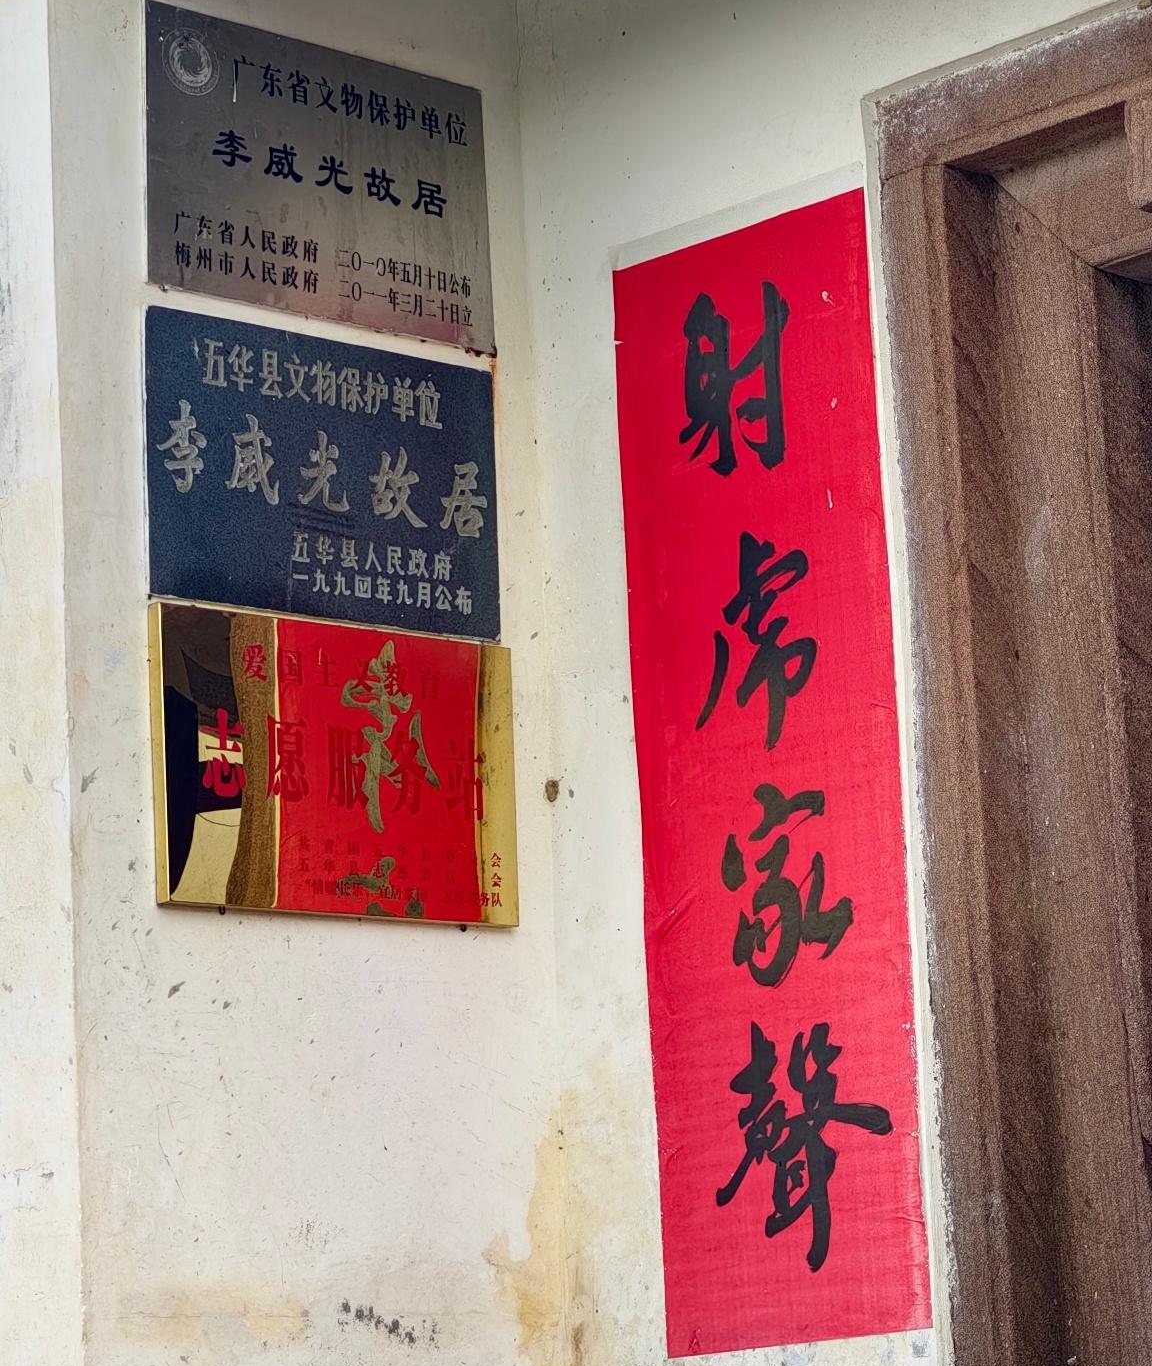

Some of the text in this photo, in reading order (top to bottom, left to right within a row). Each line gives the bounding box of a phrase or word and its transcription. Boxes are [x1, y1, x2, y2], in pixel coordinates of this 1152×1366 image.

[232, 55, 468, 147] 广东省文物保护单位
[212, 129, 448, 218] 李威光故居
[174, 210, 319, 264] 广东省人民政府
[174, 240, 319, 294] 梅州市人民政府
[203, 338, 443, 430] 五华县文物保护单位
[156, 399, 488, 538] 李威光故居
[291, 531, 452, 581] 五华县人民政府
[292, 567, 473, 616] 一九九四年九月公布
